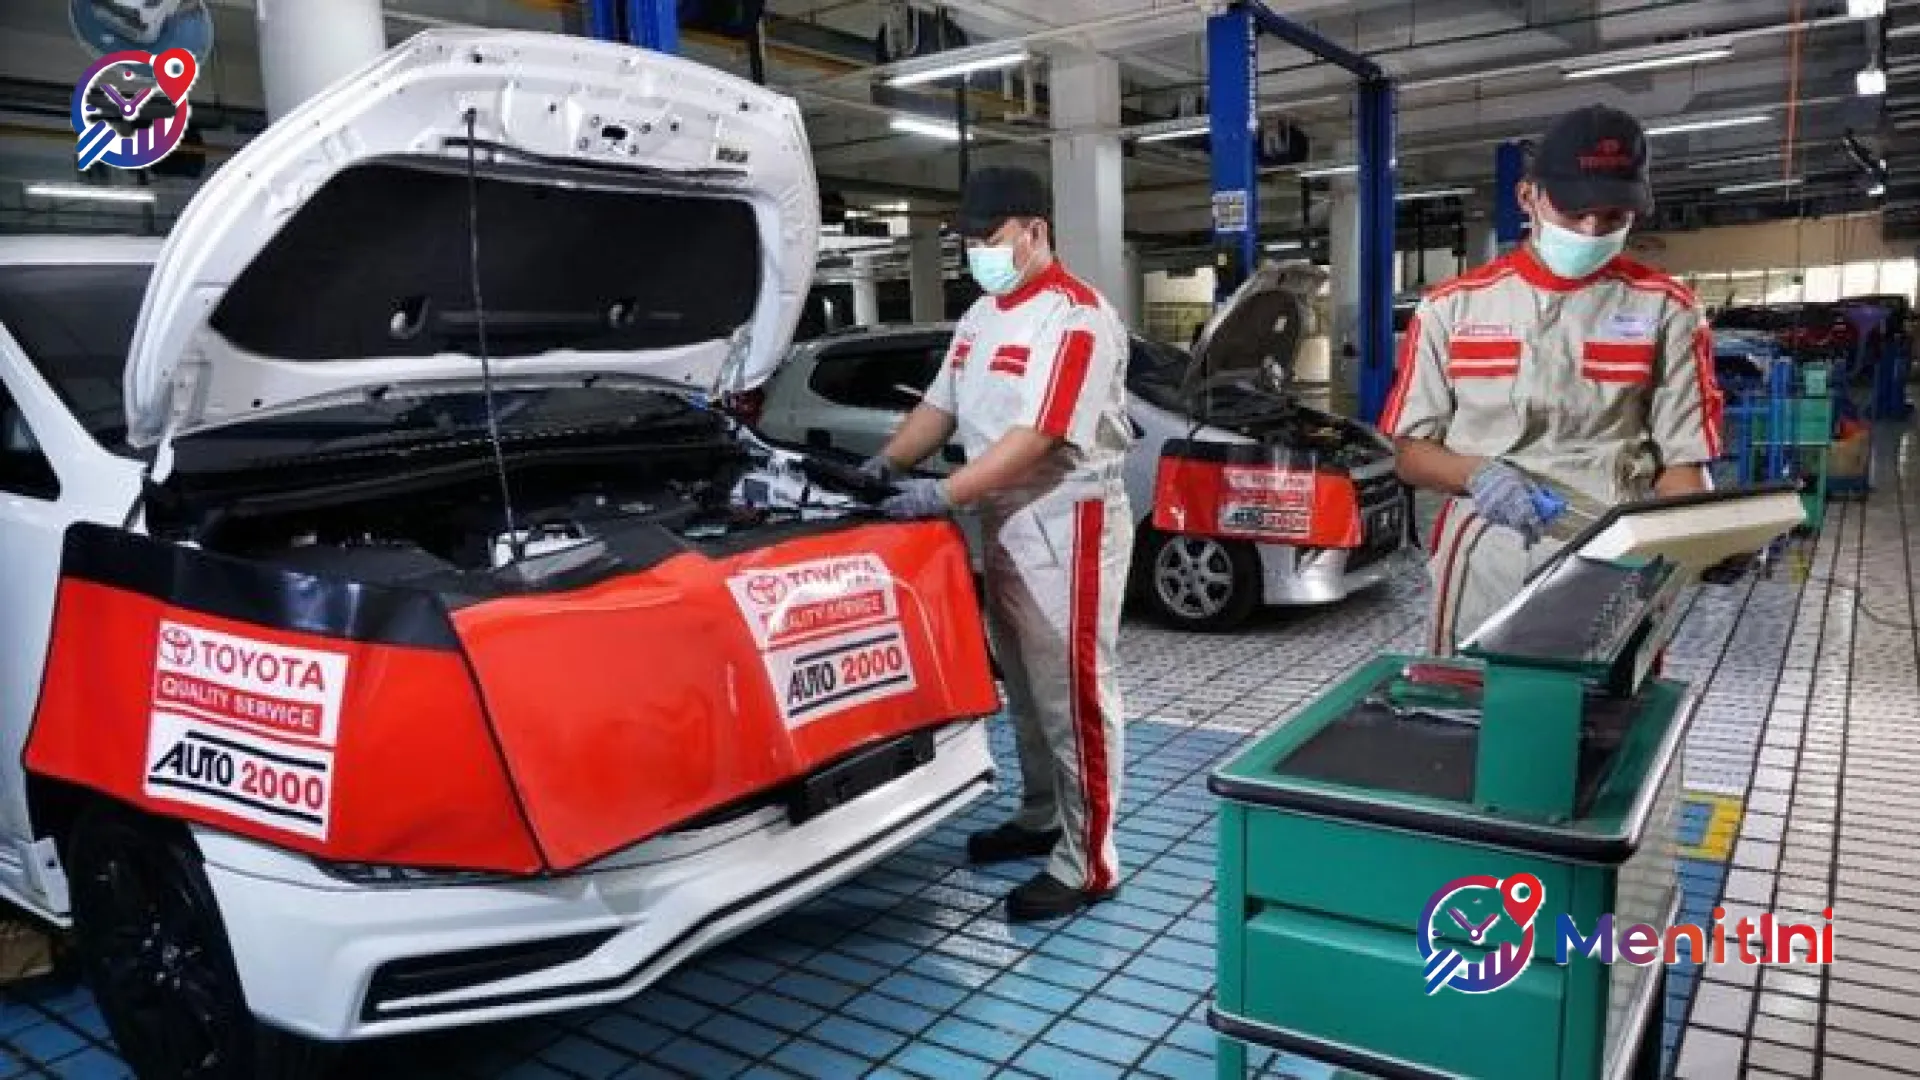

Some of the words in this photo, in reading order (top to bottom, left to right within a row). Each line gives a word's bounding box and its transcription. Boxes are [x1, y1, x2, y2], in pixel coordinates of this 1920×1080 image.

[201, 641, 325, 692] TOYOTA
[787, 661, 836, 704] AUTO
[841, 646, 901, 684] 2000
[162, 677, 228, 707] QUALITY
[235, 693, 314, 726] SERVICE
[151, 741, 234, 786] AUTO
[241, 761, 322, 810] 2000
